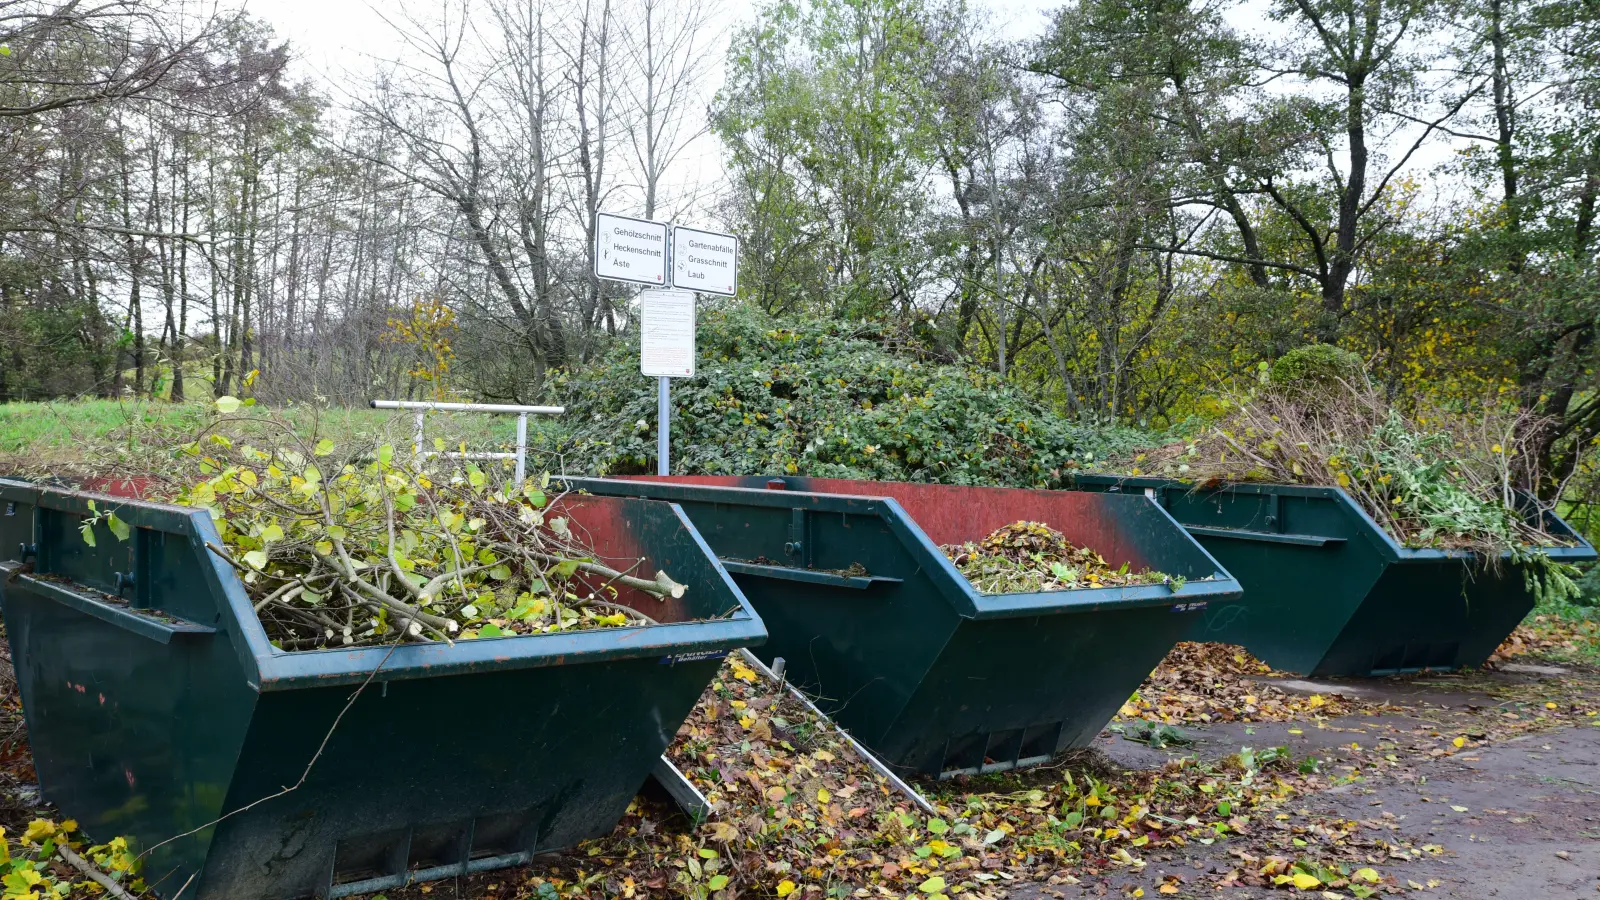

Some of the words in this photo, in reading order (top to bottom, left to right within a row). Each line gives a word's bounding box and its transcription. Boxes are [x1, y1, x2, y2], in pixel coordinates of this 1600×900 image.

[613, 227, 662, 242] Gehölzschnitt
[613, 243, 662, 257] Heckenschnitt
[688, 240, 734, 254] Gartenabfälle
[688, 255, 728, 268] Grasschnitt
[687, 270, 705, 279] Laub
